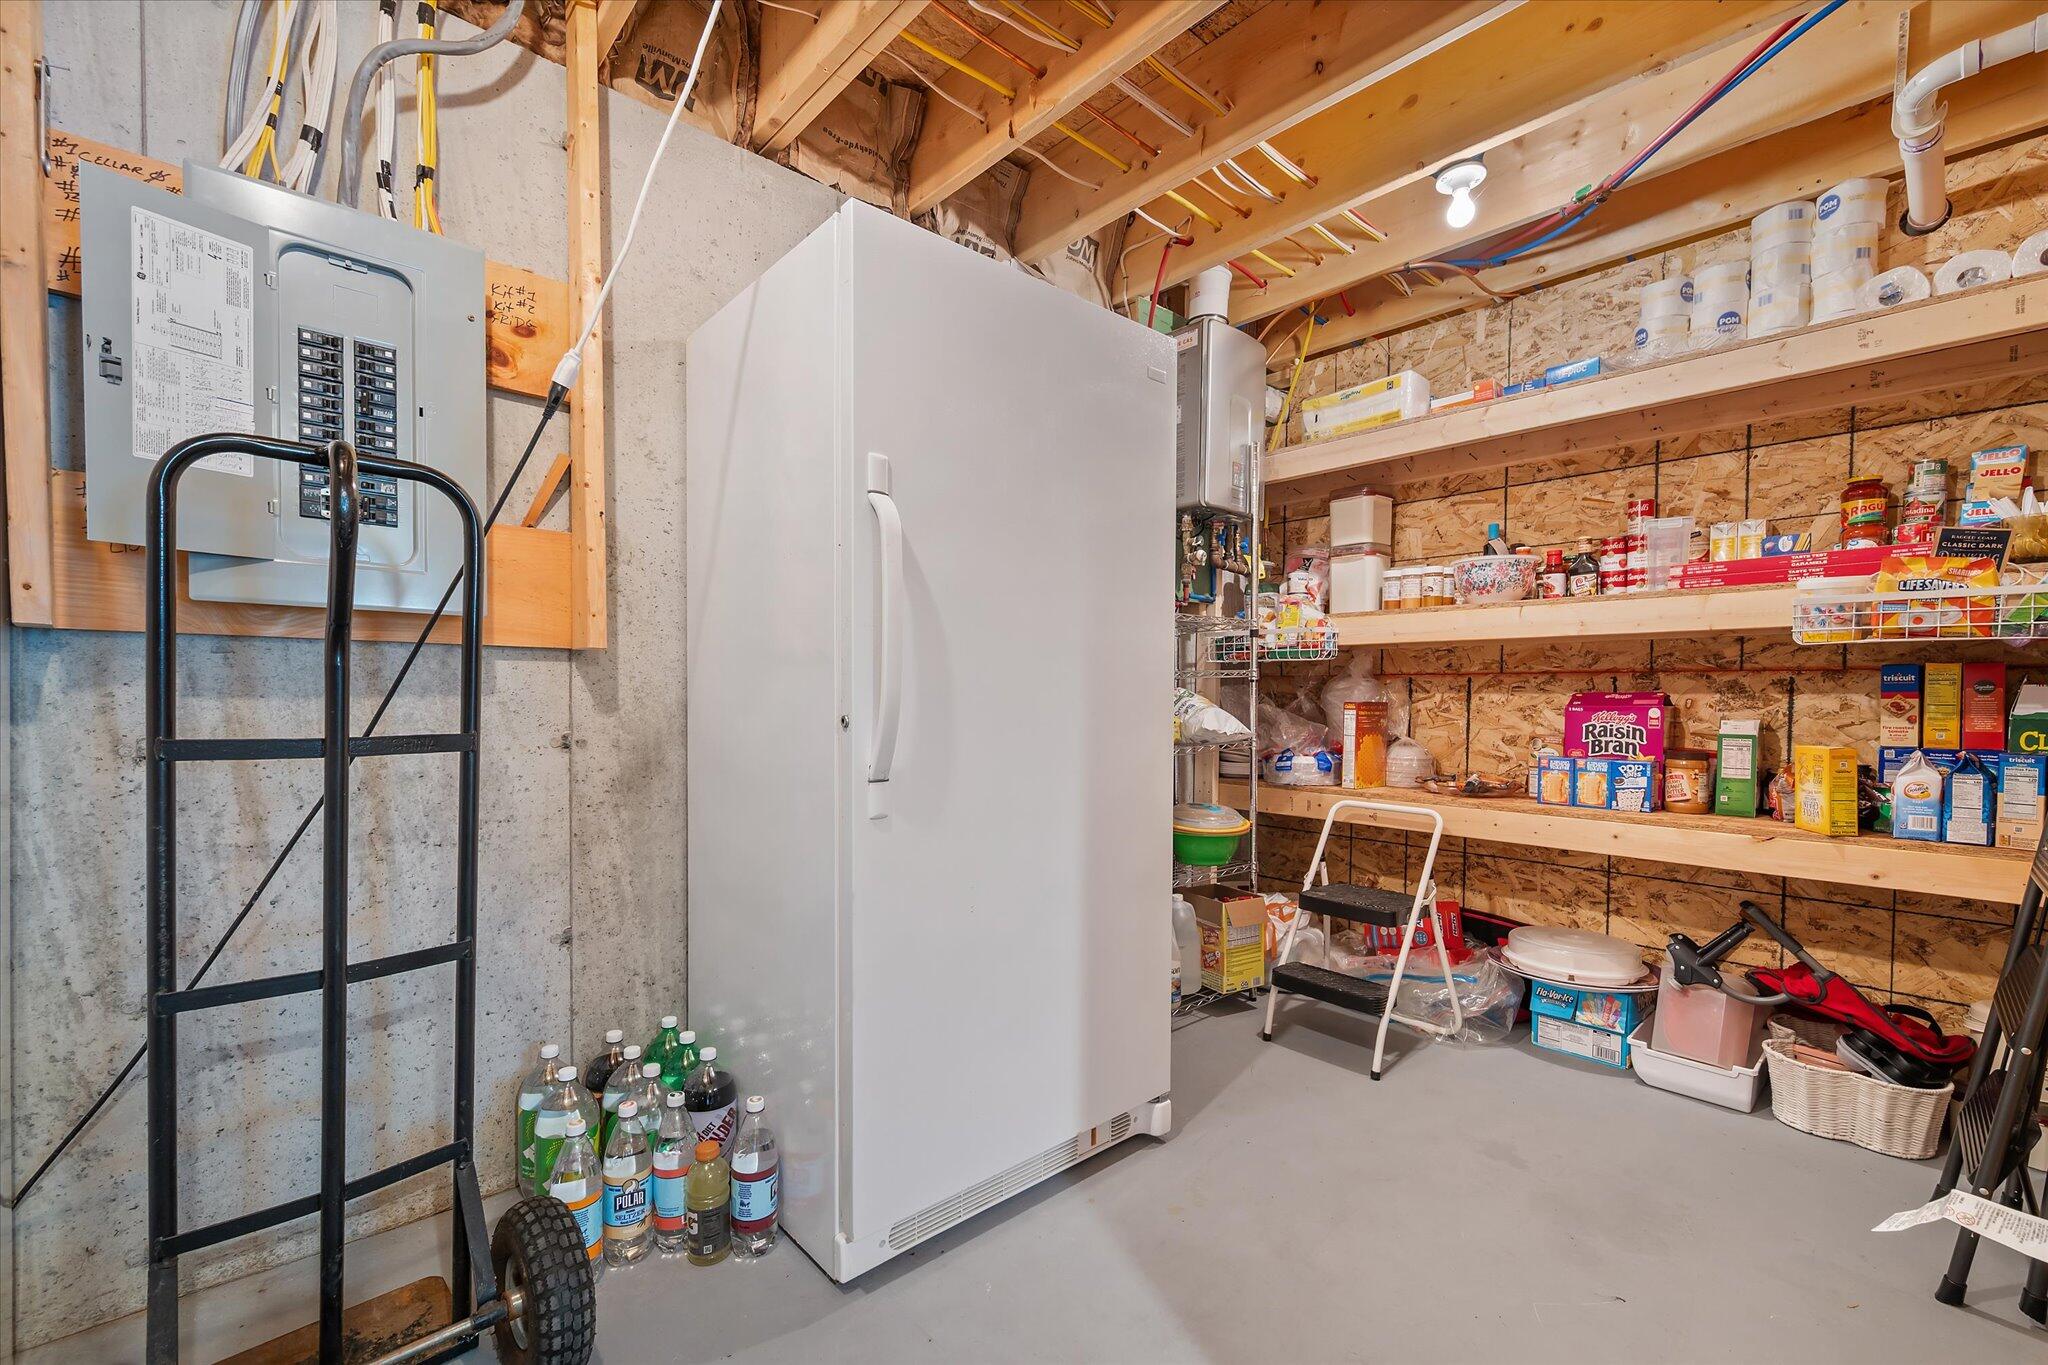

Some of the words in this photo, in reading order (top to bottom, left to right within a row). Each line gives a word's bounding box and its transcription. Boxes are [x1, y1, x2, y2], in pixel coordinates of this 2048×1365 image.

[78, 151, 145, 176] CELLAR
[1819, 198, 1838, 214] POM
[493, 300, 515, 313] Kit
[1719, 316, 1740, 325] POM
[1966, 507, 1996, 516] JELL
[1941, 541, 1977, 549] CLASSIC
[1883, 673, 1916, 682] triscuit
[1591, 711, 1638, 726] Kellogg's
[1583, 722, 1647, 743] Raisin
[1589, 740, 1640, 756] Bran
[701, 1121, 717, 1138] DIET
[615, 1191, 644, 1211] POLAR
